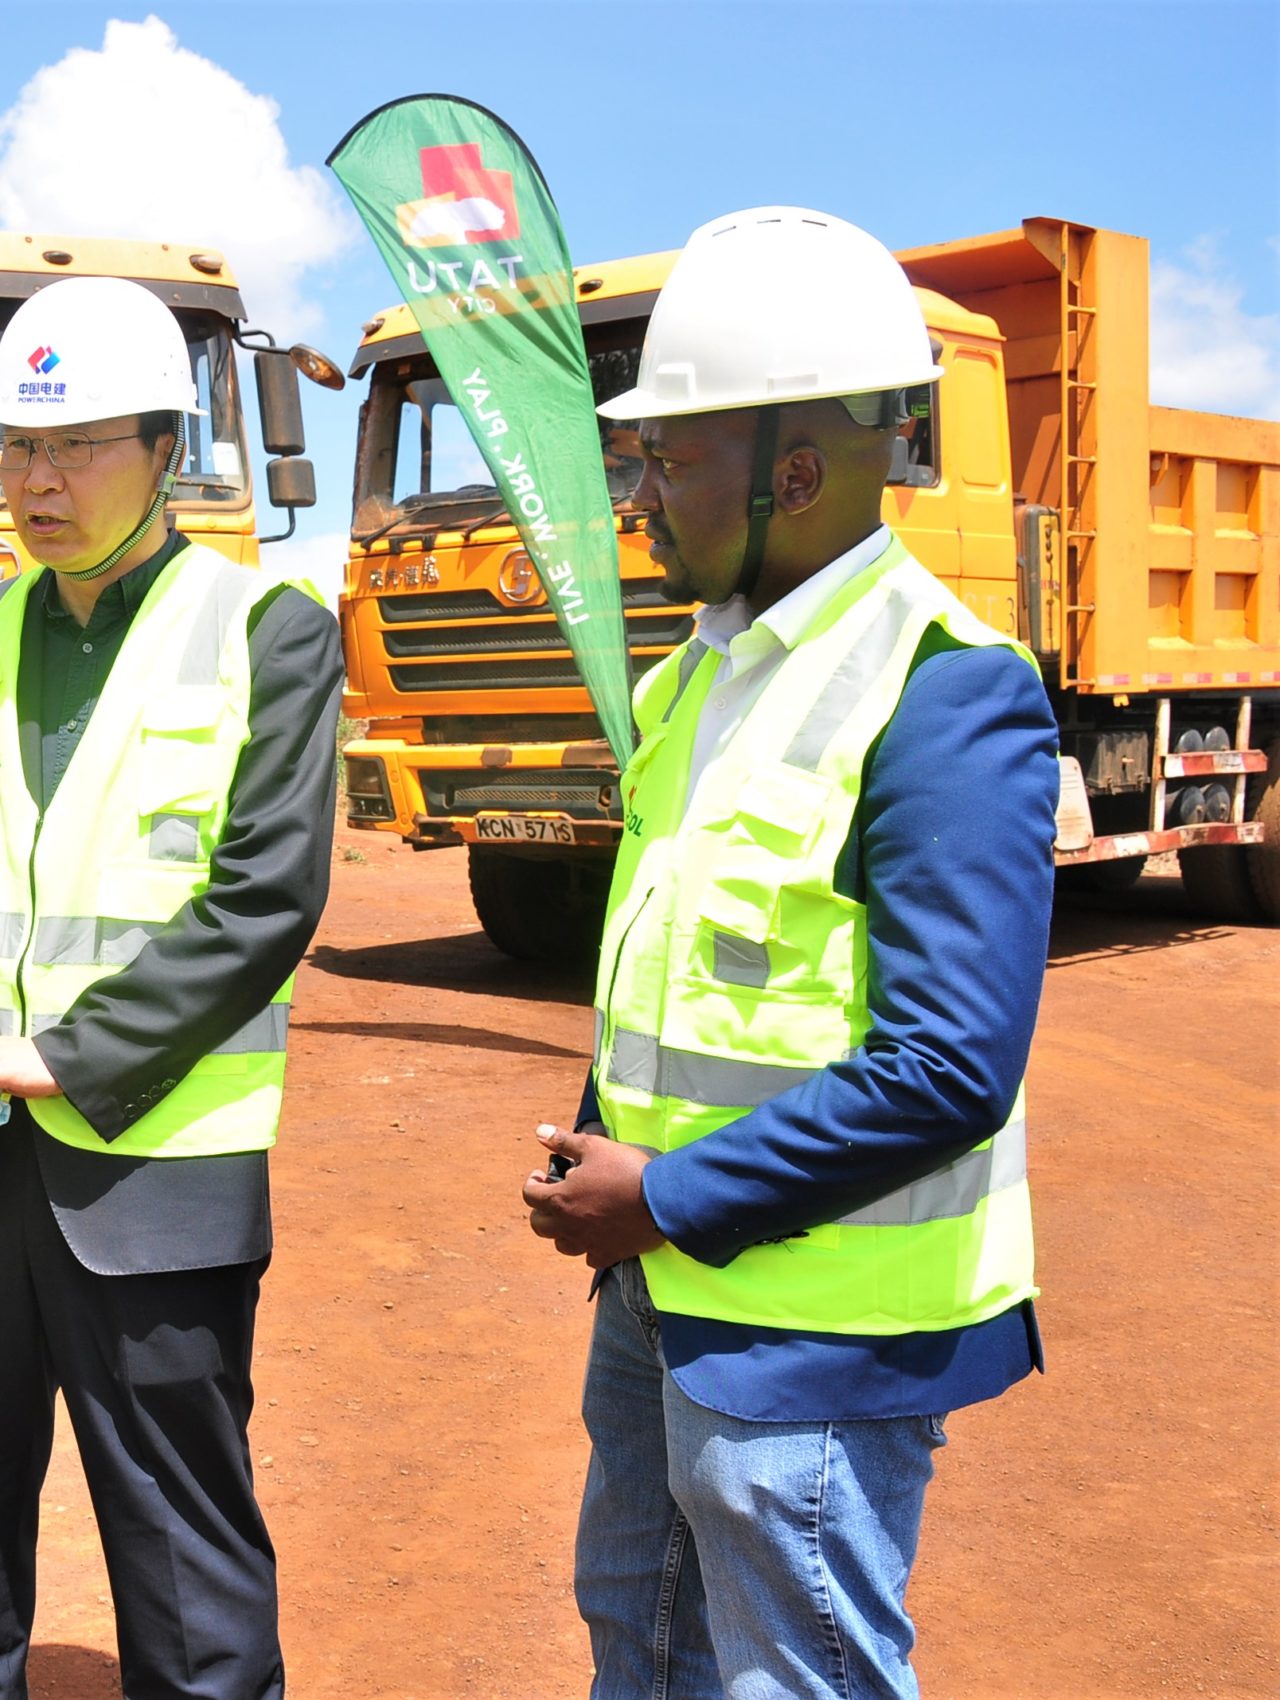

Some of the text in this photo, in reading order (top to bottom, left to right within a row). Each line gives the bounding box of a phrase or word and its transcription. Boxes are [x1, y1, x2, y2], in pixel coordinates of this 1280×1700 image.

[19, 383, 66, 395] 中国电建
[477, 817, 571, 841] KCN 571S
